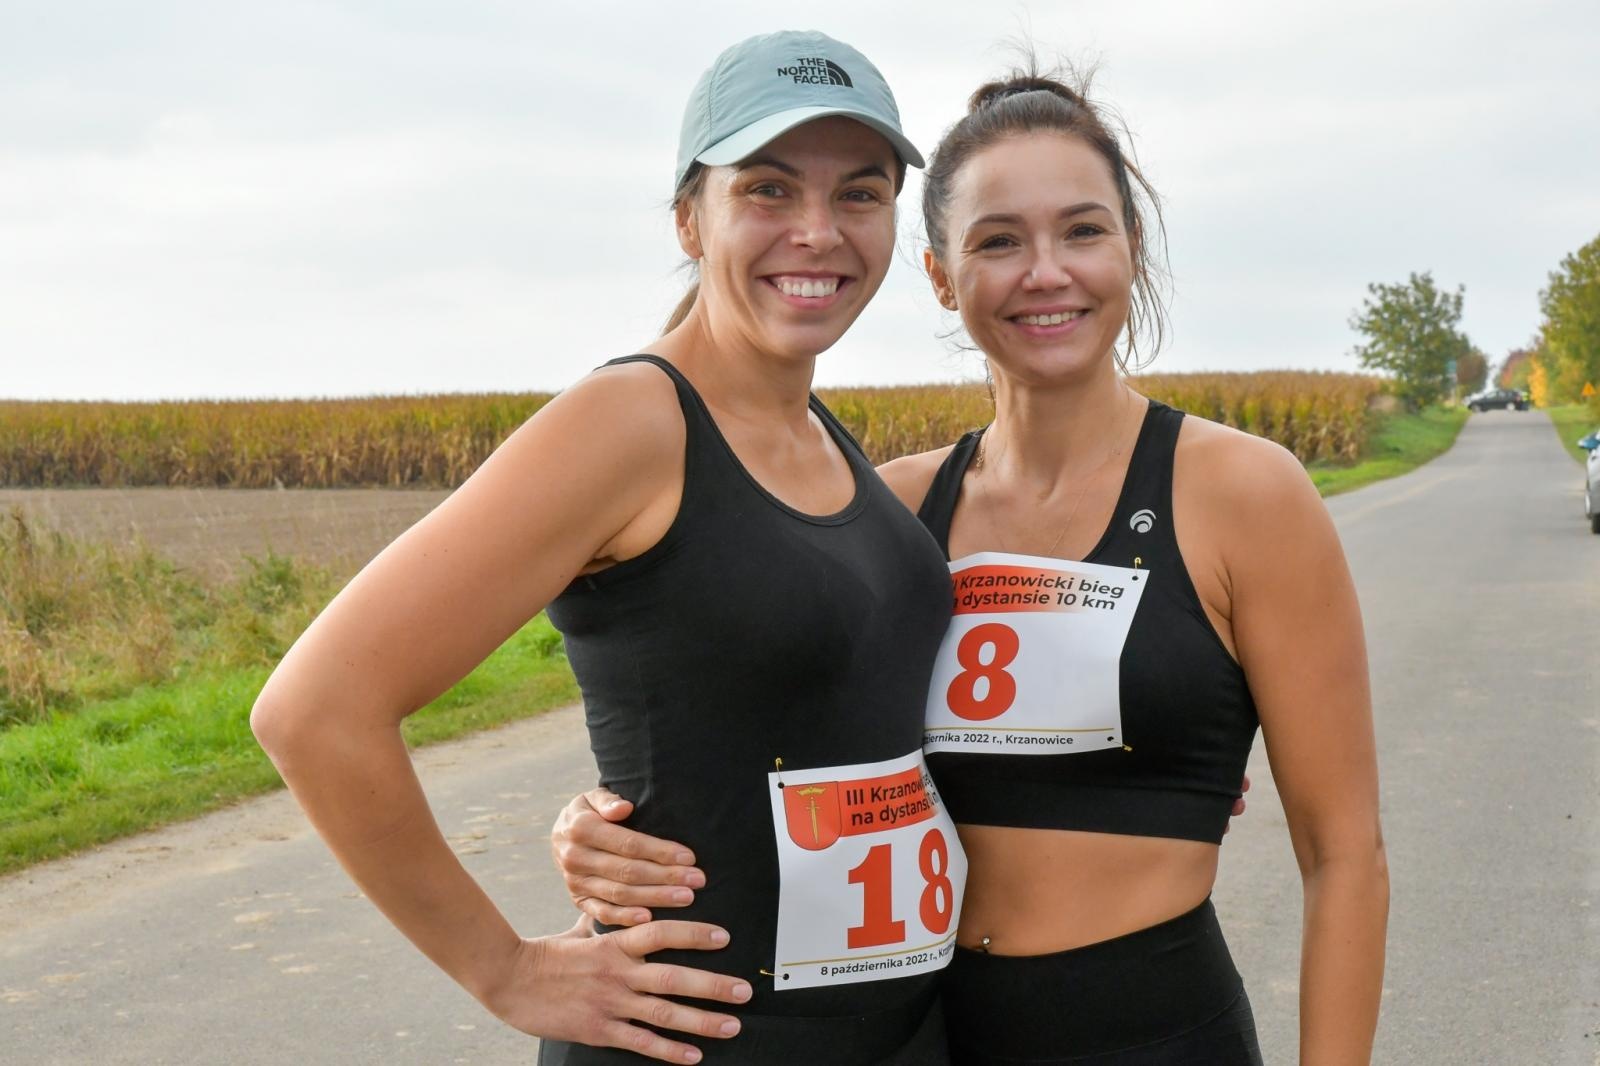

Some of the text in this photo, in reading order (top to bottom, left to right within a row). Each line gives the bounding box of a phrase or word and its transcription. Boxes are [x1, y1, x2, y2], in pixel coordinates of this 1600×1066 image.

[777, 66, 827, 76] NORTH
[797, 58, 825, 66] THE
[794, 75, 828, 84] FACE
[960, 573, 1074, 591] Krzanowicki
[1079, 579, 1124, 599] bieg
[962, 590, 1050, 609] dystansie
[1057, 592, 1077, 606] 10
[1082, 595, 1115, 611] km
[946, 622, 1020, 722] 8
[924, 732, 1074, 745] iernika 2022 r., Krzanowice
[846, 788, 864, 806] III
[852, 811, 874, 826] na
[847, 828, 954, 951] 18
[820, 966, 828, 976] 8
[831, 957, 903, 976] października
[905, 953, 928, 966] 2022
